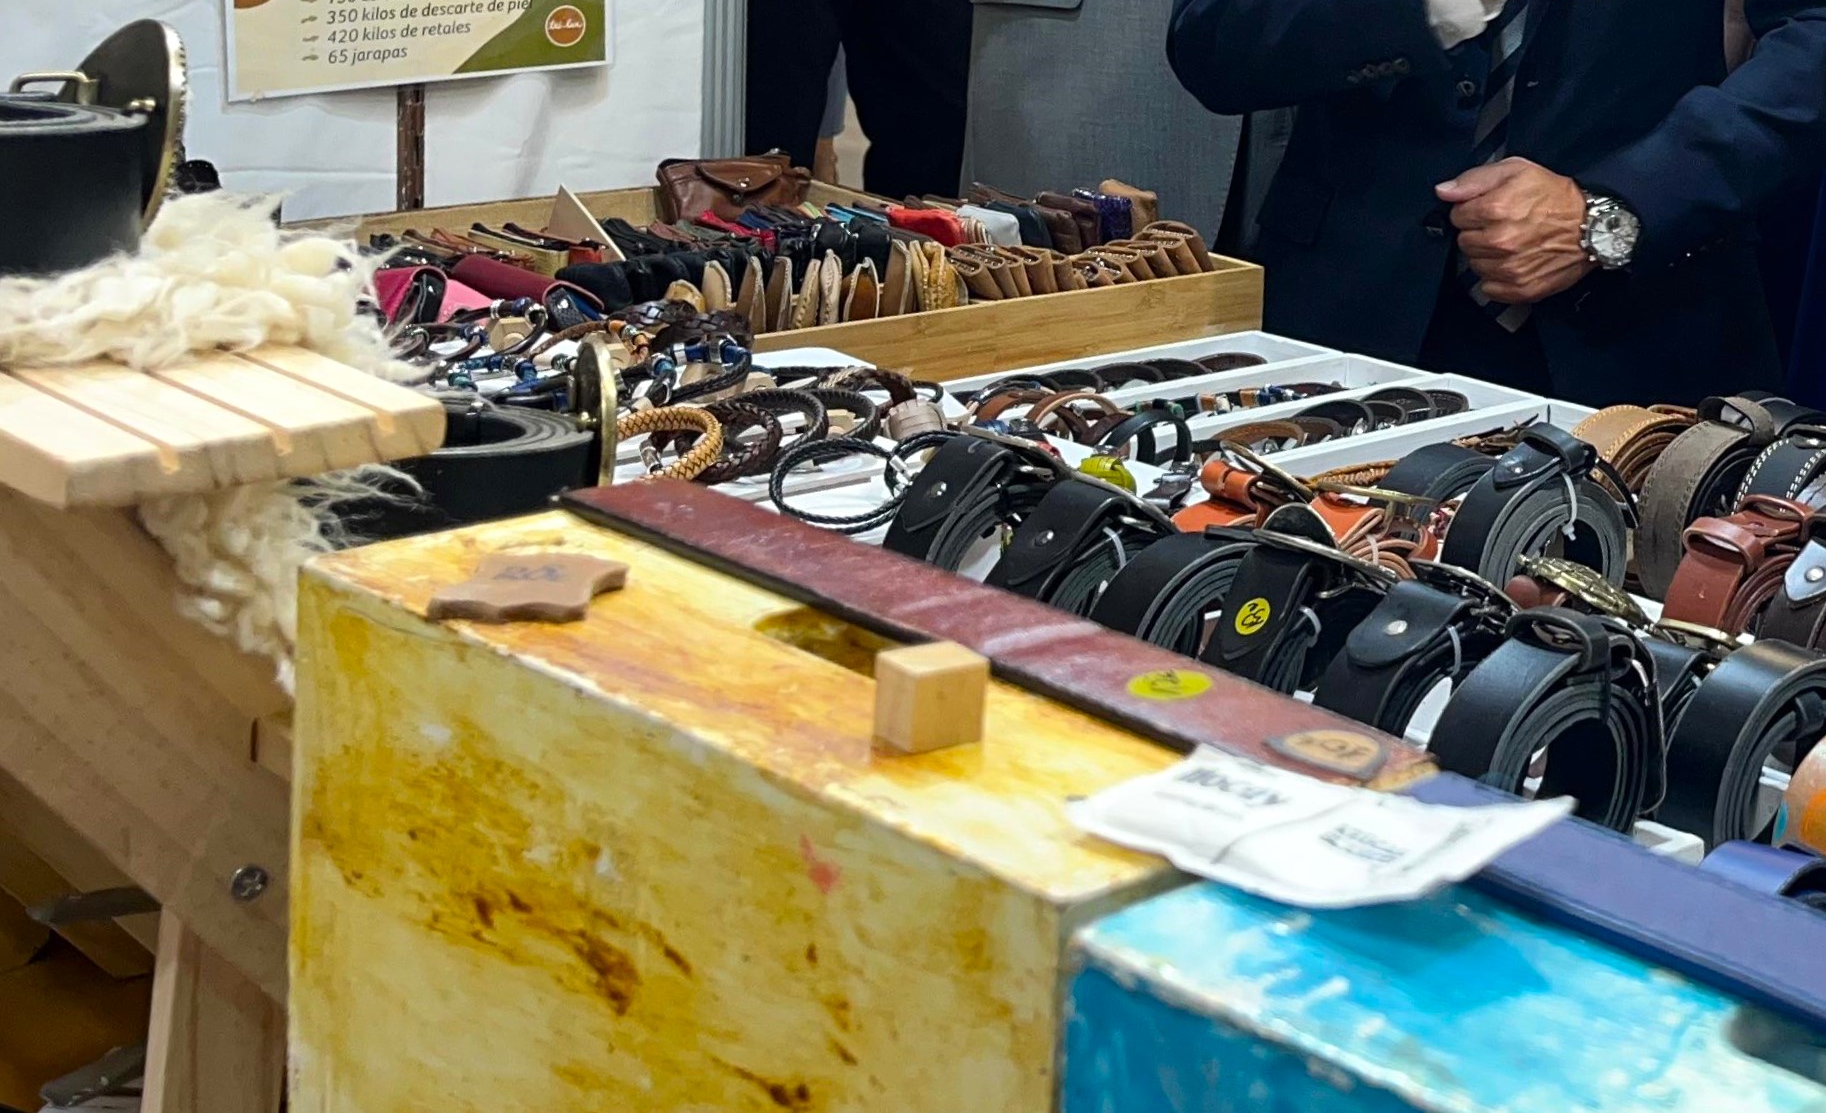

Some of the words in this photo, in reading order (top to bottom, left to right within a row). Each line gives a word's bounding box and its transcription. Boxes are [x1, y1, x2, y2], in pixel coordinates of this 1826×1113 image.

[326, 9, 358, 25] 350
[362, 6, 396, 22] kilos
[400, 4, 418, 18] de
[421, 1, 483, 17] descarte
[327, 28, 359, 43] 420
[362, 26, 396, 42] kilos
[400, 24, 418, 38] de
[421, 21, 472, 37] retales
[328, 49, 348, 64] 65
[351, 47, 408, 66] jarapas
